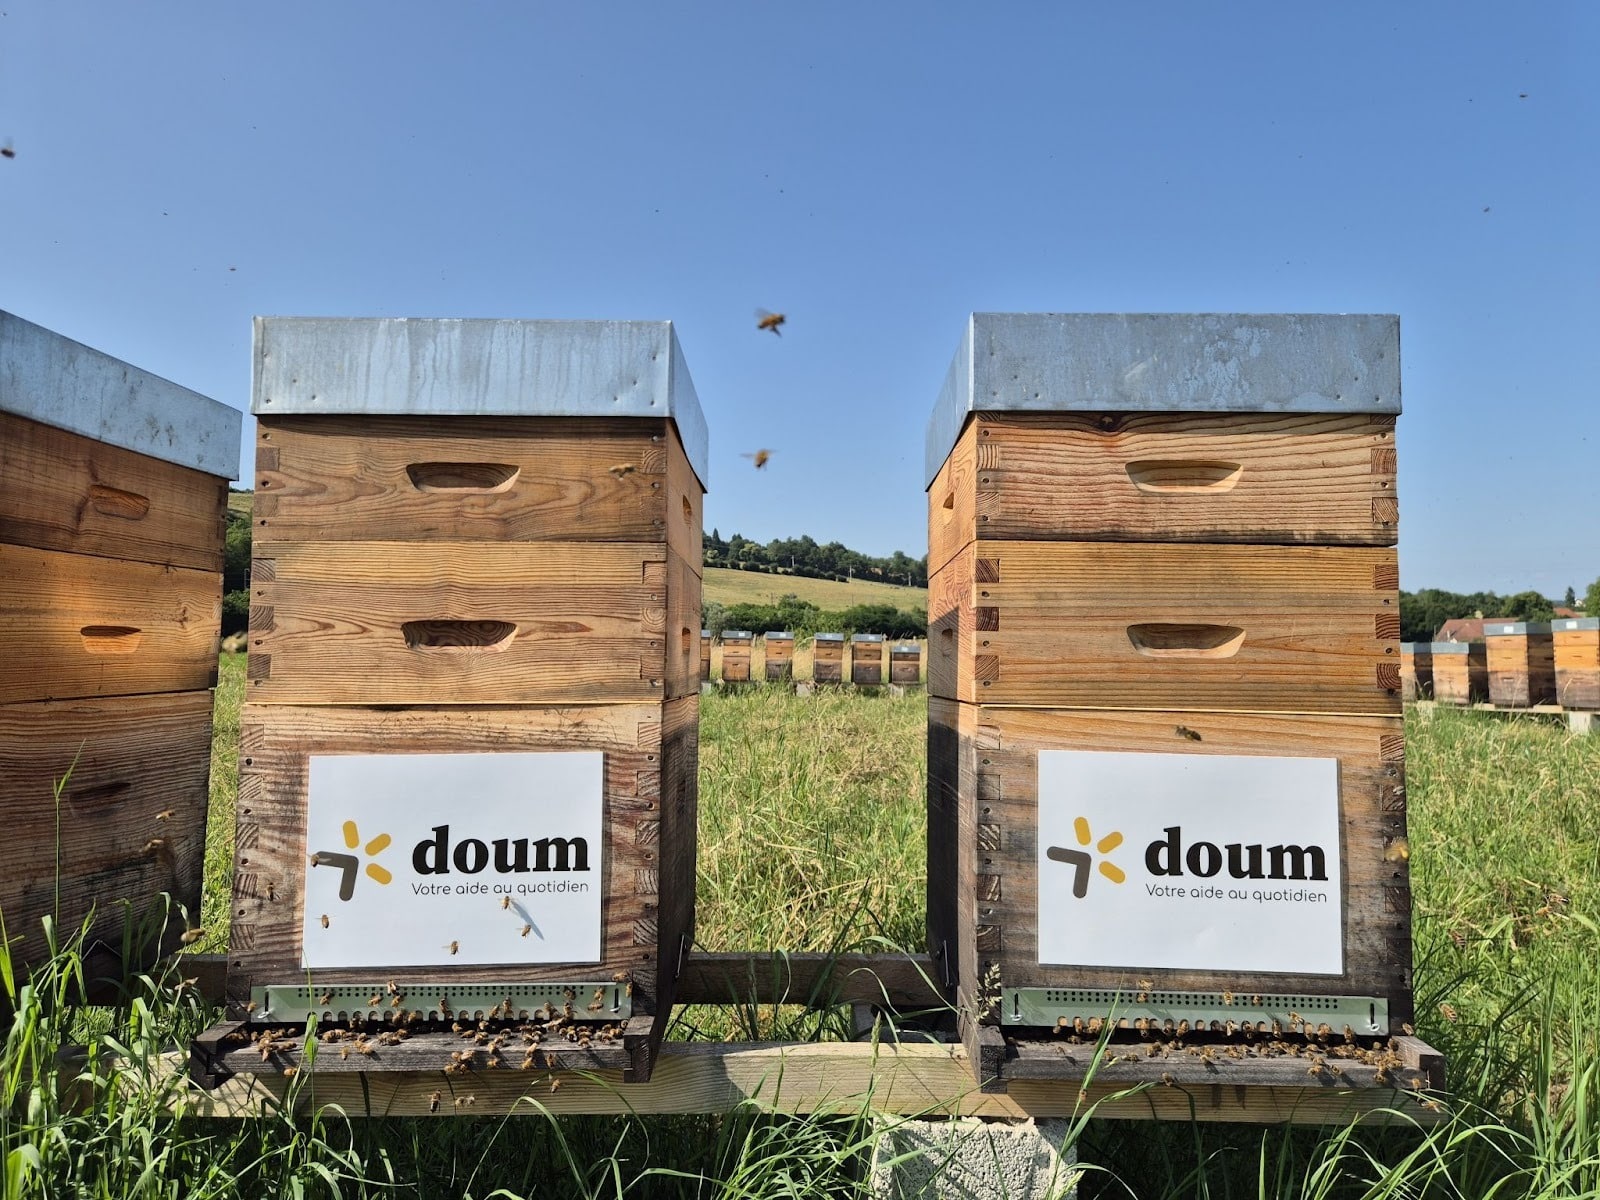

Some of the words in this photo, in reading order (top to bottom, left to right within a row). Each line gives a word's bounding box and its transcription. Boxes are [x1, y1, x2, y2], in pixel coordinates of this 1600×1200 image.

[412, 825, 590, 875] doum
[1145, 826, 1328, 881] doum
[411, 882, 452, 896] Votre
[455, 881, 489, 895] aide
[493, 884, 512, 894] au
[516, 879, 589, 897] quotidien
[1145, 883, 1186, 898] Votre
[1190, 885, 1224, 899] aide
[1228, 889, 1248, 900] au
[1252, 888, 1327, 904] quotidien
